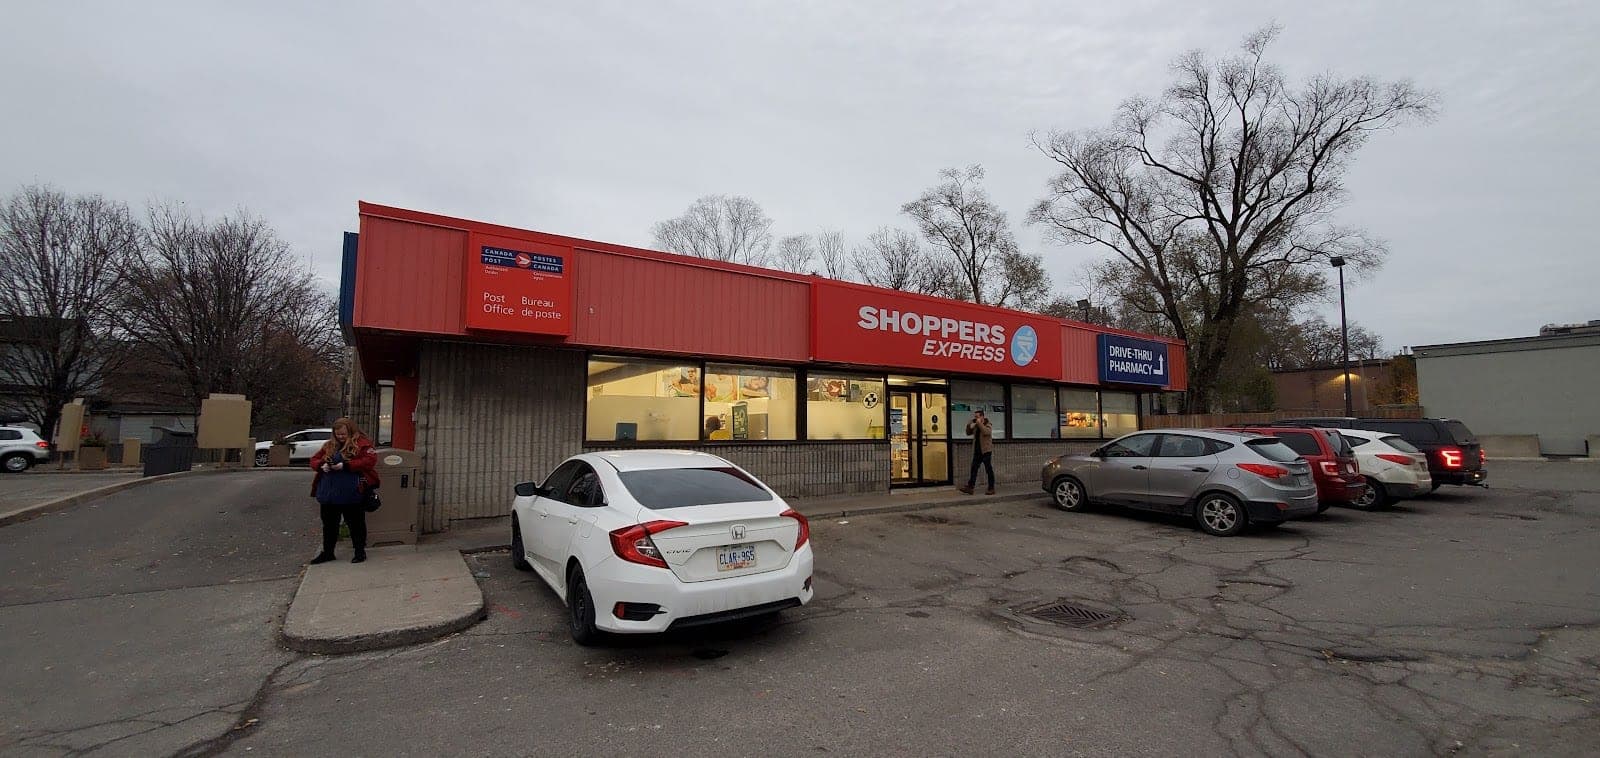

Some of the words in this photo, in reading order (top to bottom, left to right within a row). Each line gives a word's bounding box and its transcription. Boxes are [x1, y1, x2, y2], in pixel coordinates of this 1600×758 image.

[485, 248, 513, 257] CANADA
[533, 255, 557, 263] POSTES
[483, 292, 505, 303] Post
[521, 296, 554, 308] Bureau
[483, 303, 514, 315] Office
[521, 308, 533, 317] de
[535, 311, 561, 320] poste
[857, 305, 1006, 345] SHOPPERS
[922, 339, 1006, 363] EXPRESS
[1109, 345, 1153, 362] DRIVE-THRU
[1109, 359, 1153, 376] PHARMACY
